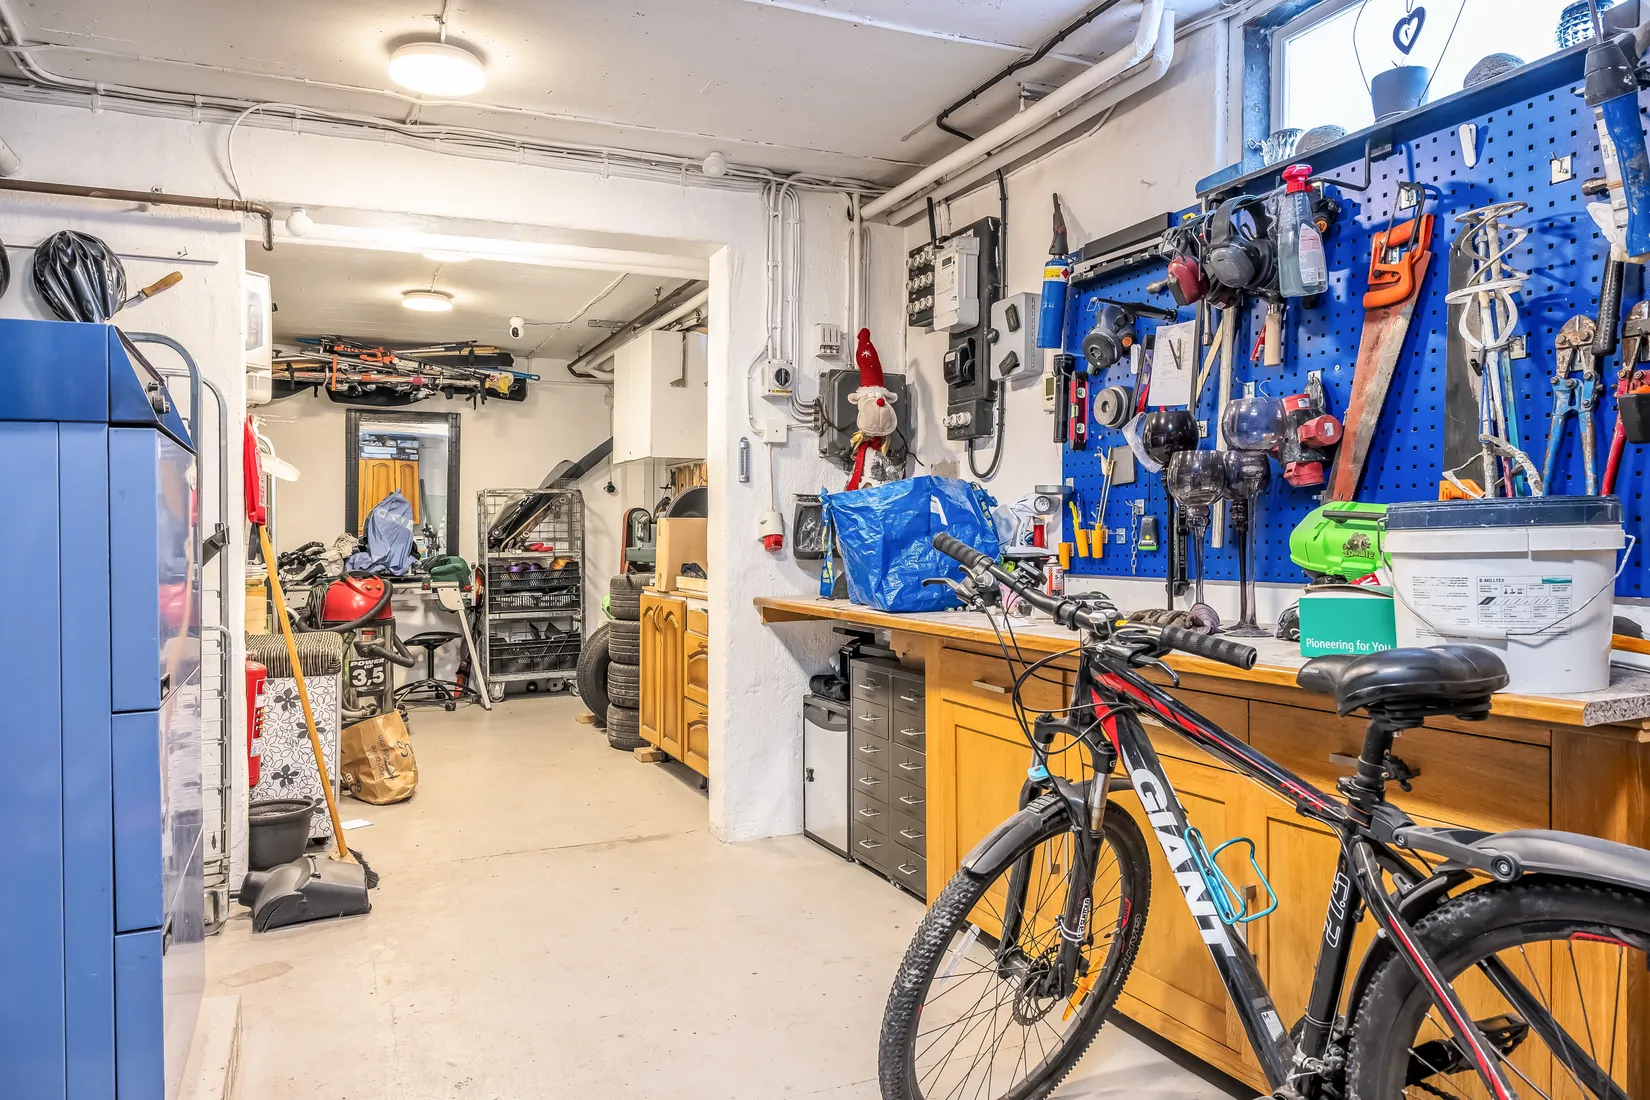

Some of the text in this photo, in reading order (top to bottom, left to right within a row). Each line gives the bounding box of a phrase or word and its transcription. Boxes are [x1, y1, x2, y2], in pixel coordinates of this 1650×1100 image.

[1306, 638, 1391, 652] Pioneering for You
[350, 658, 385, 667] POWER
[352, 666, 385, 686] 3,5
[1131, 768, 1237, 957] GIANT
